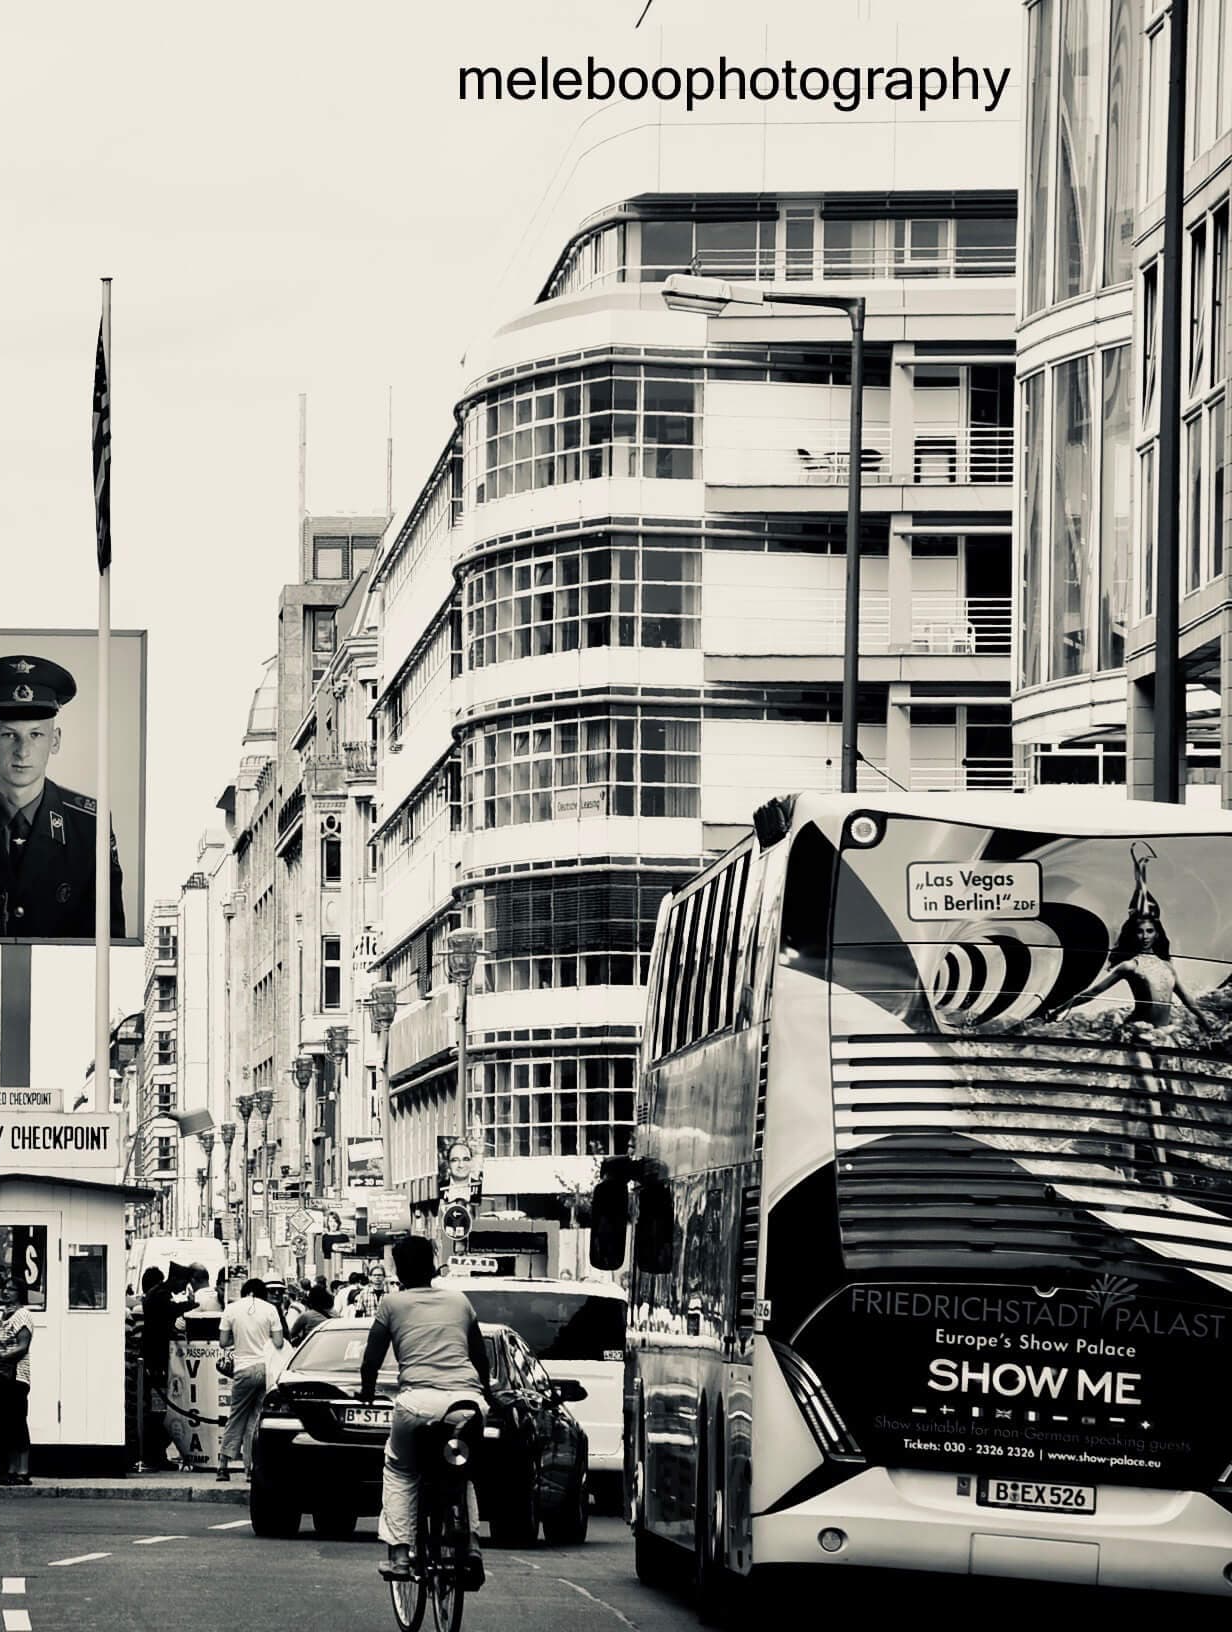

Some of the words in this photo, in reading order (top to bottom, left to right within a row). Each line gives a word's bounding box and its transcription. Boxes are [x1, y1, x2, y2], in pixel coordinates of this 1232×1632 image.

[960, 870, 1014, 891] Vegas
[923, 896, 938, 911] in
[1013, 900, 1036, 911] ZDF
[9, 1092, 52, 1106] CHECKPOINT
[11, 1126, 110, 1150] CHECKPOINT
[851, 1288, 1094, 1329] FRIEDRICHSTADT
[1115, 1307, 1226, 1339] PALAST
[935, 1328, 1012, 1351] Europe's
[1019, 1333, 1069, 1352] Show
[1076, 1338, 1137, 1358] Palace
[927, 1358, 1069, 1399] SHOW
[1076, 1368, 1142, 1405] ME
[347, 1409, 355, 1420] B
[364, 1410, 381, 1422] ST
[873, 1415, 910, 1430] Show
[915, 1418, 967, 1434] suitable
[971, 1421, 989, 1436] for
[1085, 1432, 1145, 1452] speaking
[903, 1438, 941, 1452] Tickets:
[944, 1441, 966, 1453] 030
[976, 1444, 1004, 1456] 2326
[1007, 1446, 1035, 1459] 2326
[1048, 1451, 1161, 1468] www.show-palace.eu
[996, 1482, 1008, 1501] B
[1021, 1484, 1046, 1505] EX
[1050, 1486, 1086, 1507] 526
